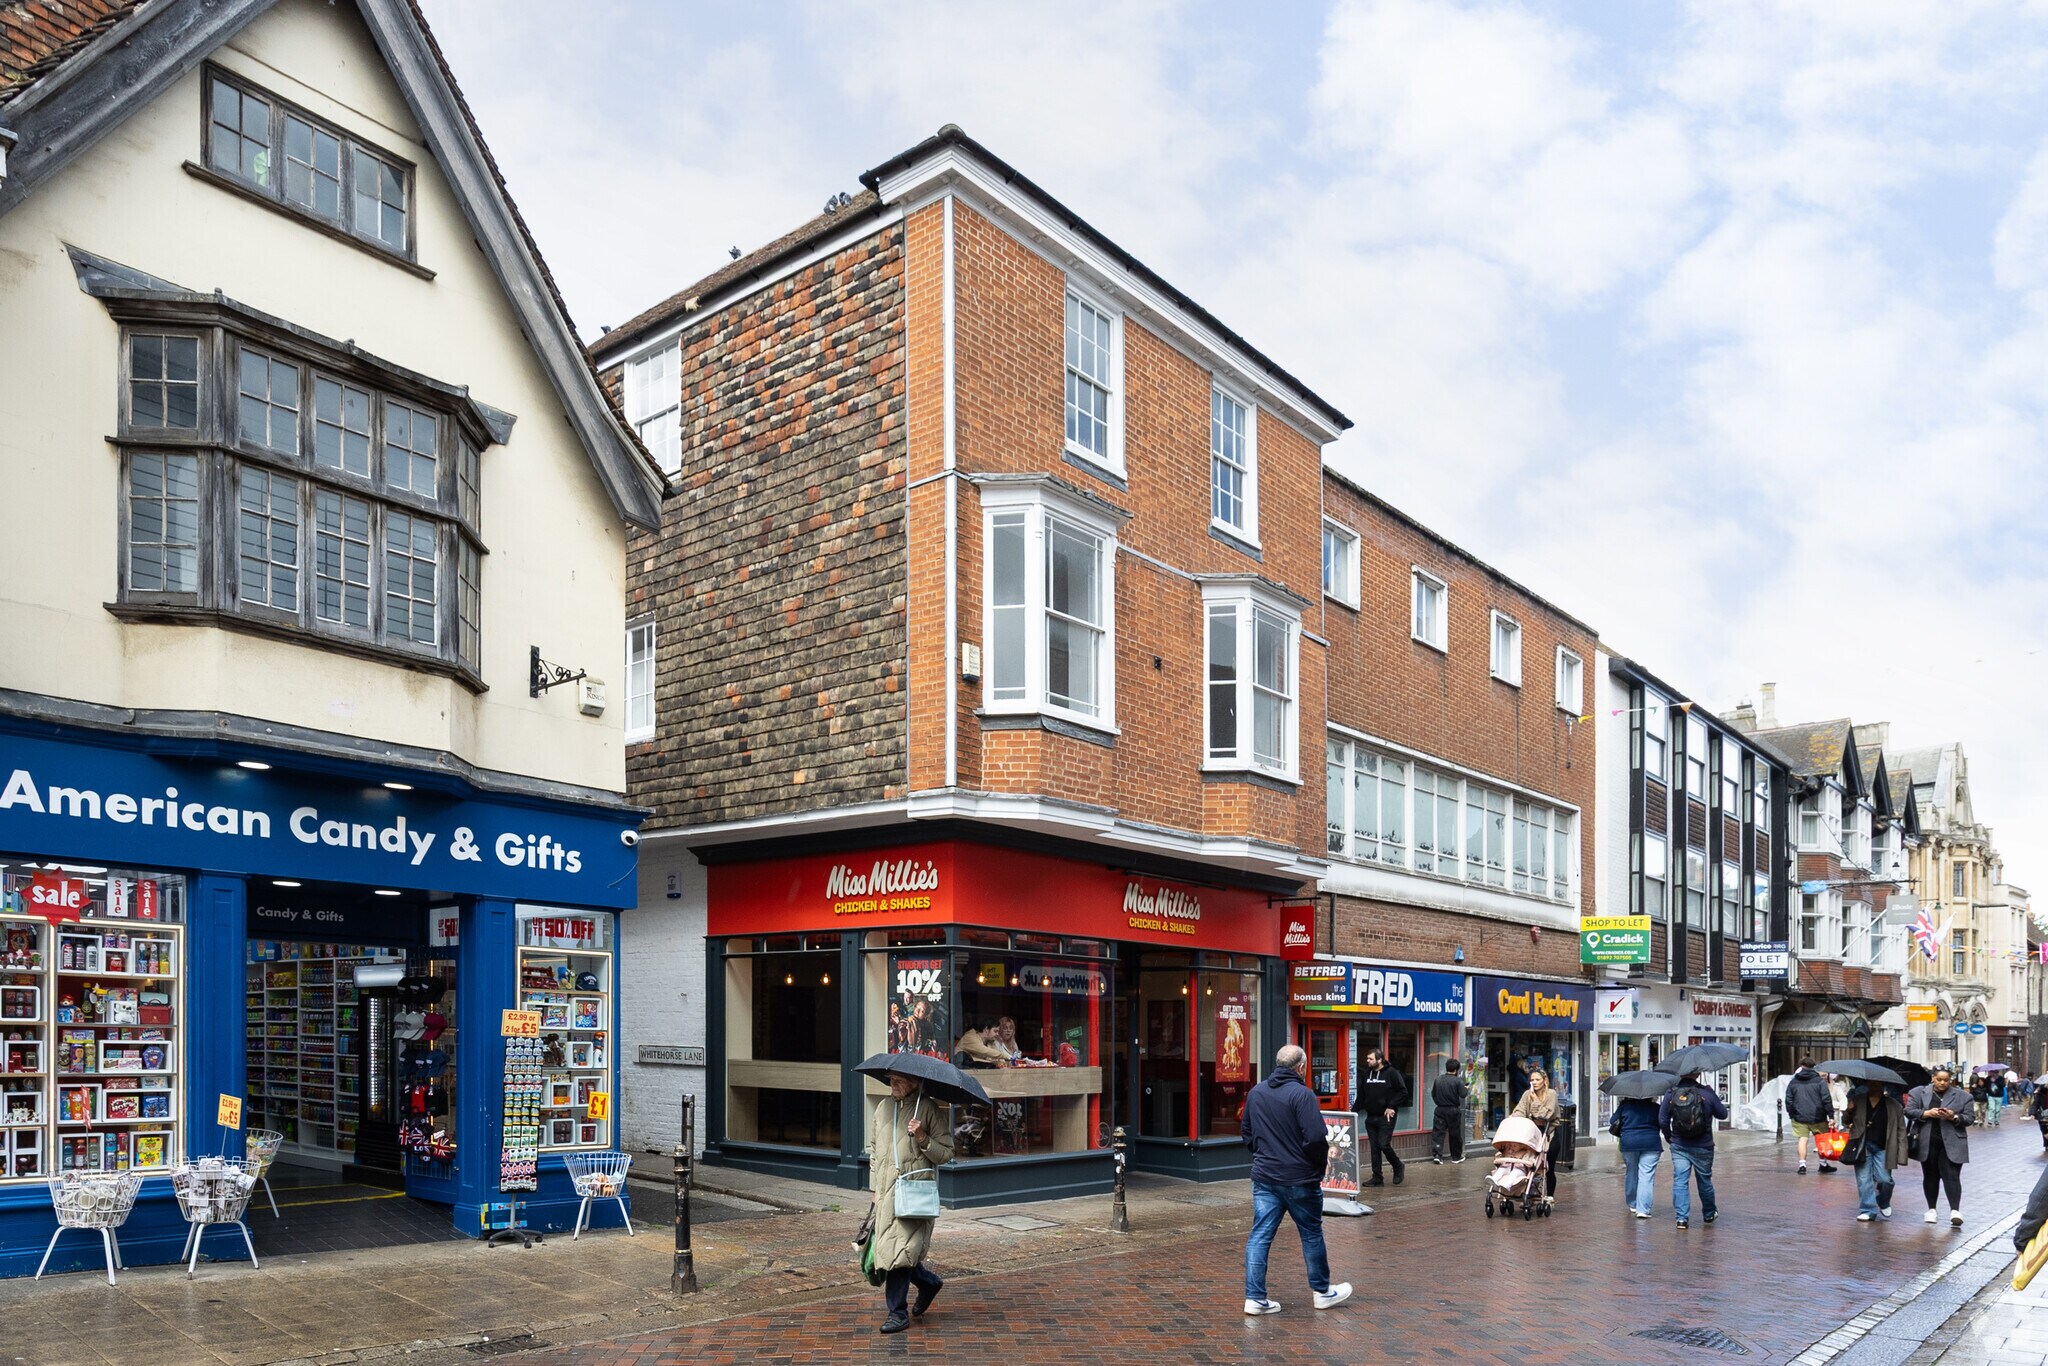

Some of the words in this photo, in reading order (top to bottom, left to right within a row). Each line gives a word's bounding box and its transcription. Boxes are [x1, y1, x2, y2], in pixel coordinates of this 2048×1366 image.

[0, 769, 270, 838] American
[289, 806, 436, 865] Candy
[450, 827, 482, 862] &
[495, 832, 582, 873] Gifts
[826, 864, 866, 899] Miss
[868, 860, 938, 895] Millie's
[114, 879, 122, 914] sale
[143, 881, 151, 916] sale
[1123, 882, 1154, 914] Miss
[1154, 887, 1200, 920] Millie's
[834, 900, 877, 914] CHICKEN
[880, 899, 888, 911] &
[890, 896, 931, 910] SHAKES
[257, 906, 298, 921] Candy
[302, 909, 312, 920] &
[316, 910, 344, 922] Gifts
[532, 917, 543, 927] UP
[545, 917, 570, 938] 50%
[571, 920, 594, 940] OFF
[1129, 917, 1161, 931] CHICKEN
[1162, 921, 1169, 931] &
[1169, 921, 1195, 935] SHAKES
[1289, 921, 1305, 933] Miss
[1586, 919, 1610, 927] SHOP
[532, 927, 543, 936] TO
[1284, 933, 1310, 944] Millie's
[1602, 933, 1644, 943] Cradick
[897, 960, 928, 970] STUDENTS
[929, 959, 942, 968] GET
[1760, 955, 1781, 963] LET
[1294, 966, 1345, 977] BETFRED
[897, 969, 942, 994] 10%
[1353, 968, 1413, 1007] FRED
[1294, 993, 1322, 1001] bonus
[1326, 993, 1346, 1002] king
[1452, 984, 1463, 997] the
[1414, 998, 1442, 1013] bonus
[1445, 999, 1463, 1016] king
[1498, 988, 1530, 1014] Card
[1534, 992, 1579, 1023] Factory
[508, 1013, 528, 1021] £2.99
[511, 1025, 520, 1033] for
[521, 1023, 537, 1034] £5
[641, 1050, 682, 1060] WHITEHORSE
[684, 1052, 702, 1061] LANE
[590, 1096, 606, 1116] £1
[229, 1111, 238, 1125] £5
[1325, 1125, 1350, 1142] 0%
